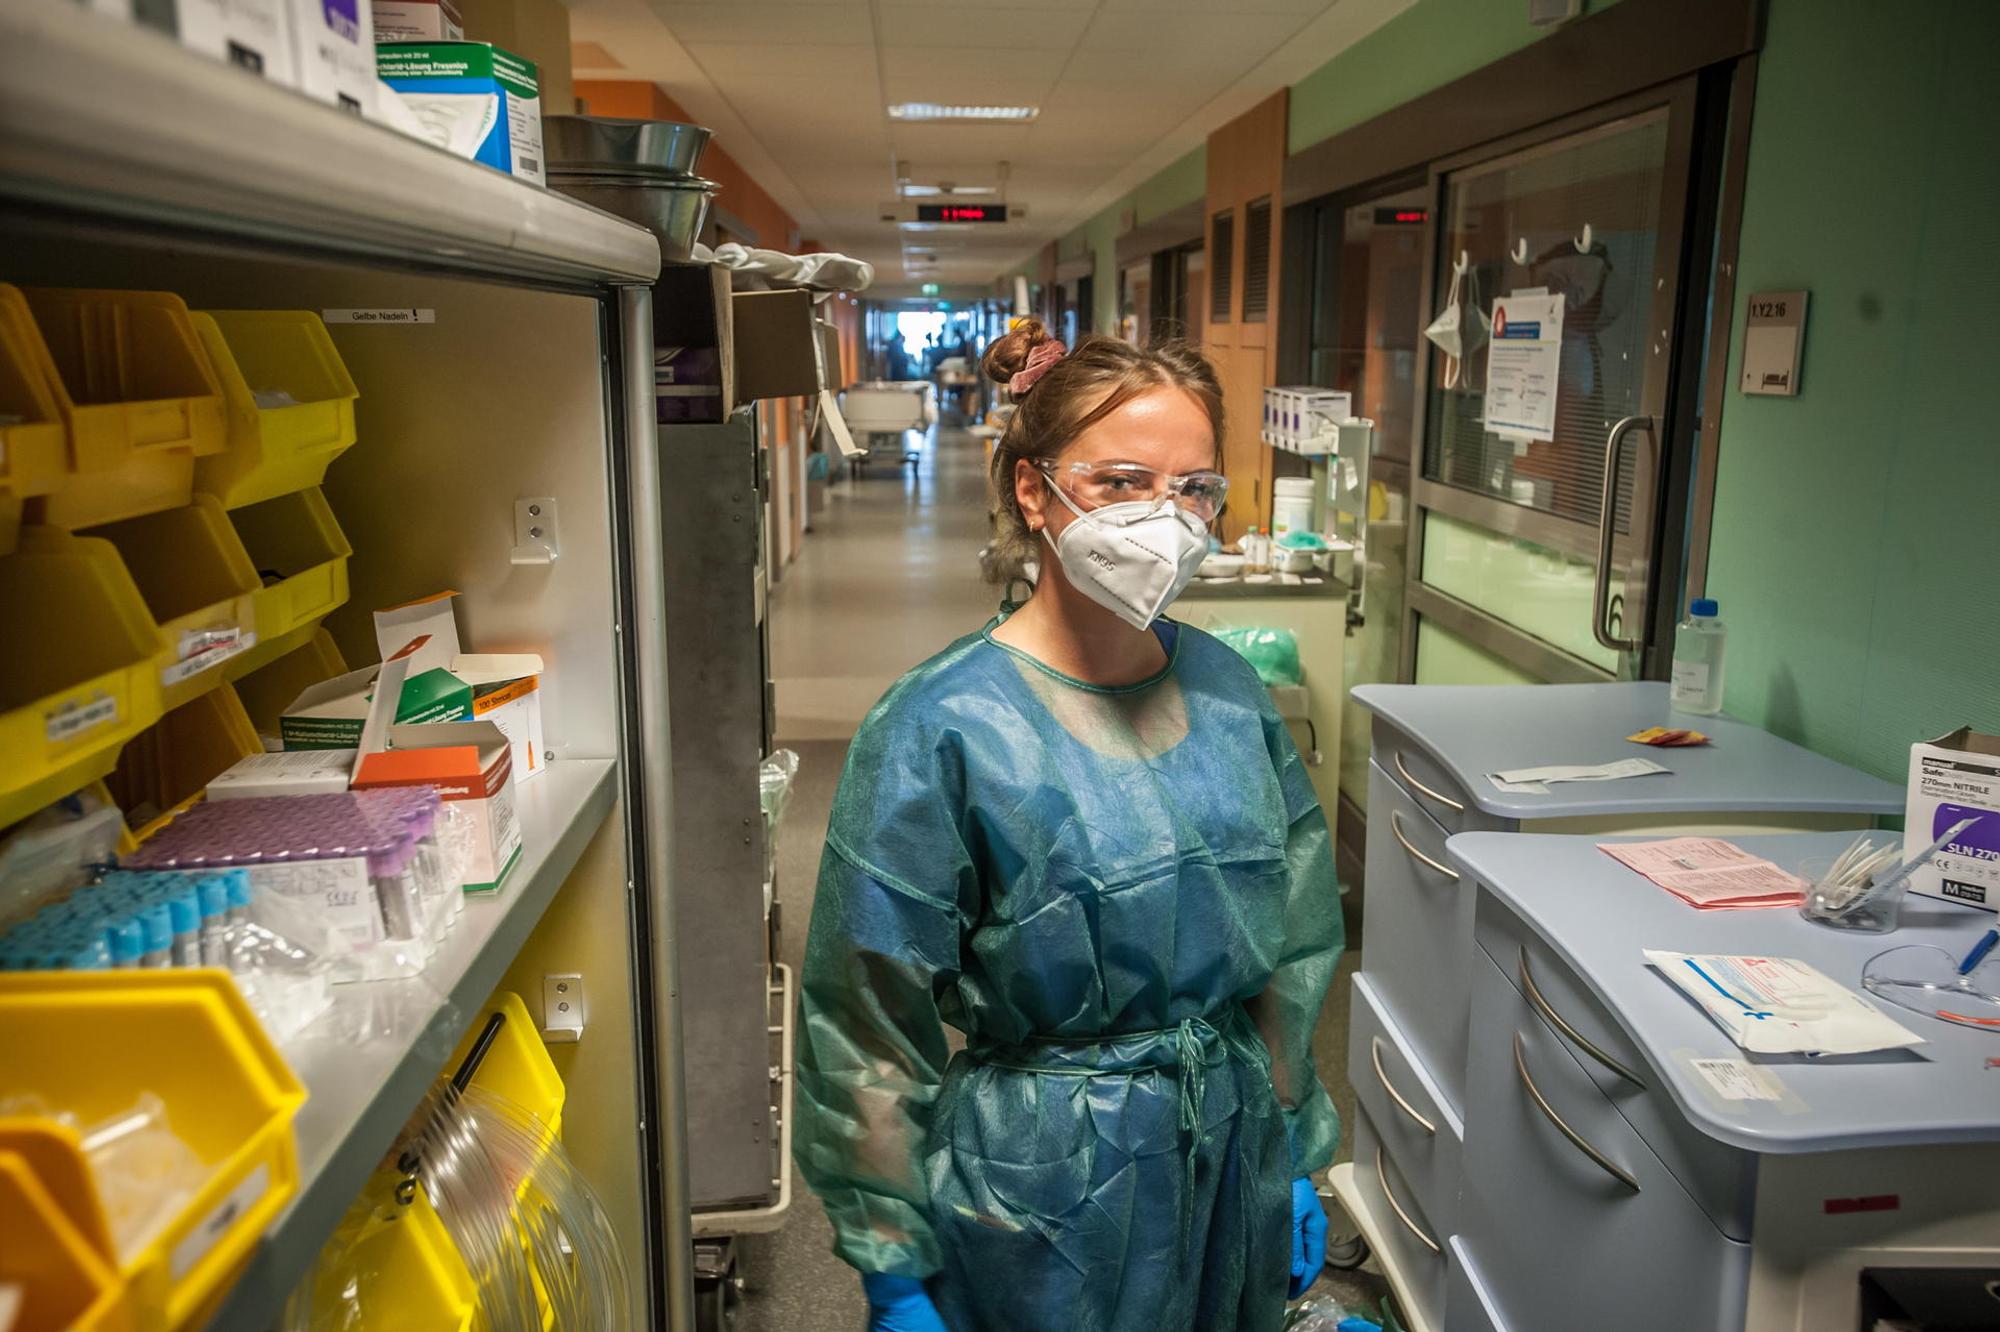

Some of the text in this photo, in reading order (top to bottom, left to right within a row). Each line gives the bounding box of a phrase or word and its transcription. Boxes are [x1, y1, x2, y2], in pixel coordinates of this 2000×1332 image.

[352, 311, 409, 321] Gelbe Nadeln
[1087, 549, 1117, 572] KN95
[1953, 782, 1990, 795] NITRILE
[1947, 842, 2000, 861] SLN 270
[1945, 882, 1959, 896] M
